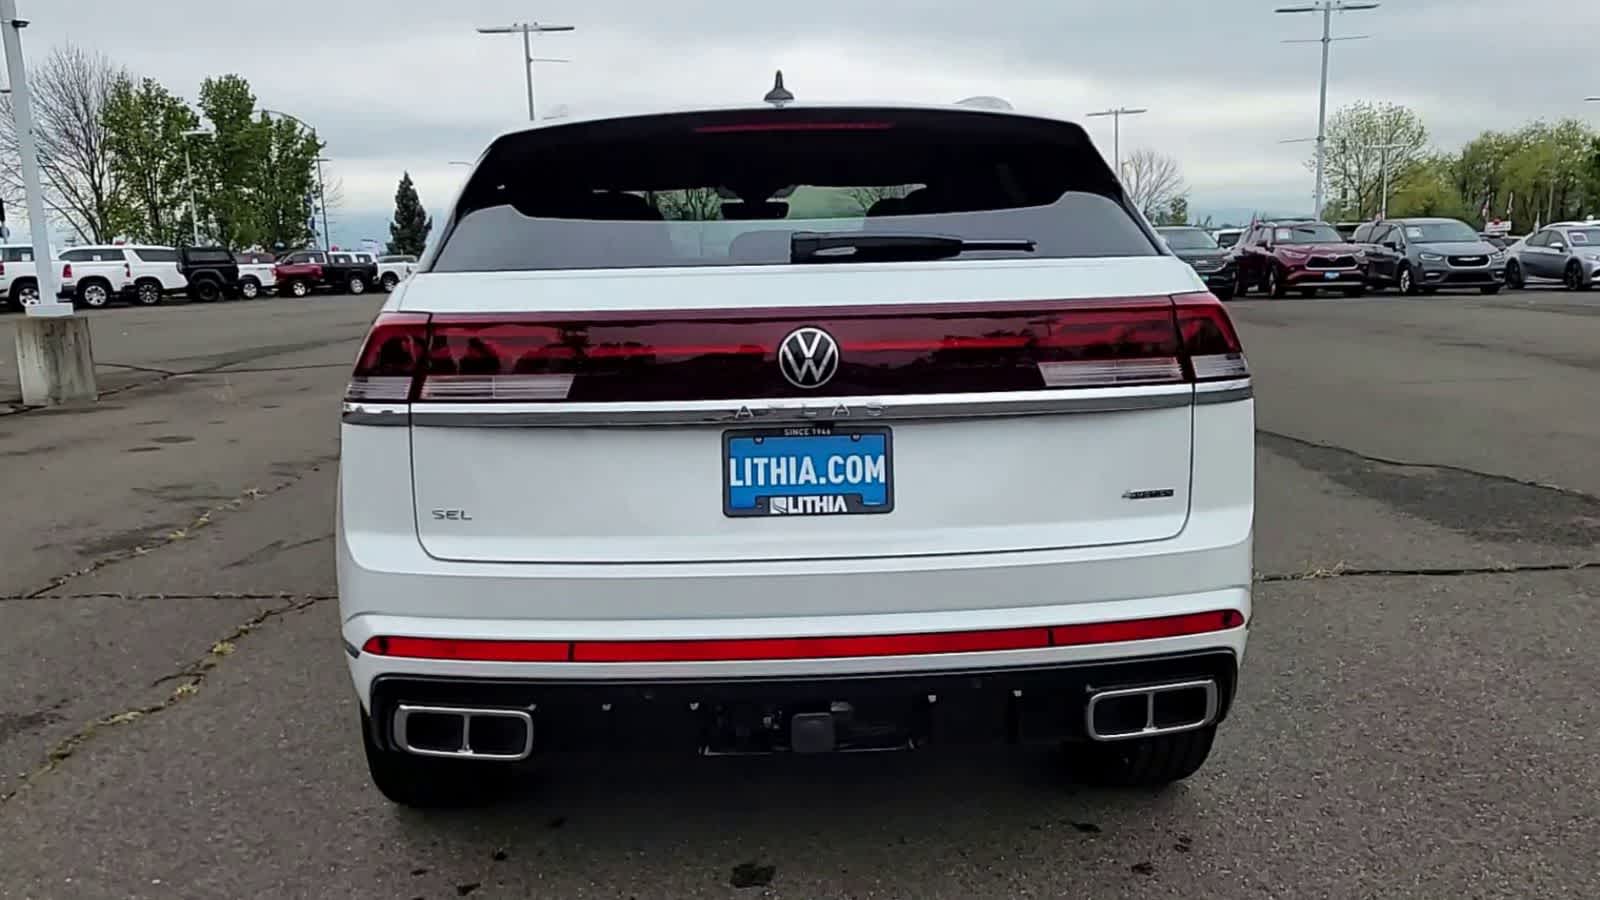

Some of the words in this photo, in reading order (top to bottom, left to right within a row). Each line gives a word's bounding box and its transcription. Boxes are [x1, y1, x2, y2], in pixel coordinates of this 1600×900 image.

[735, 403, 882, 419] ALAS
[784, 428, 809, 436] SINCE
[730, 455, 885, 486] LITHIA.COM
[787, 496, 848, 513] LITHIA
[431, 510, 473, 520] SEL
